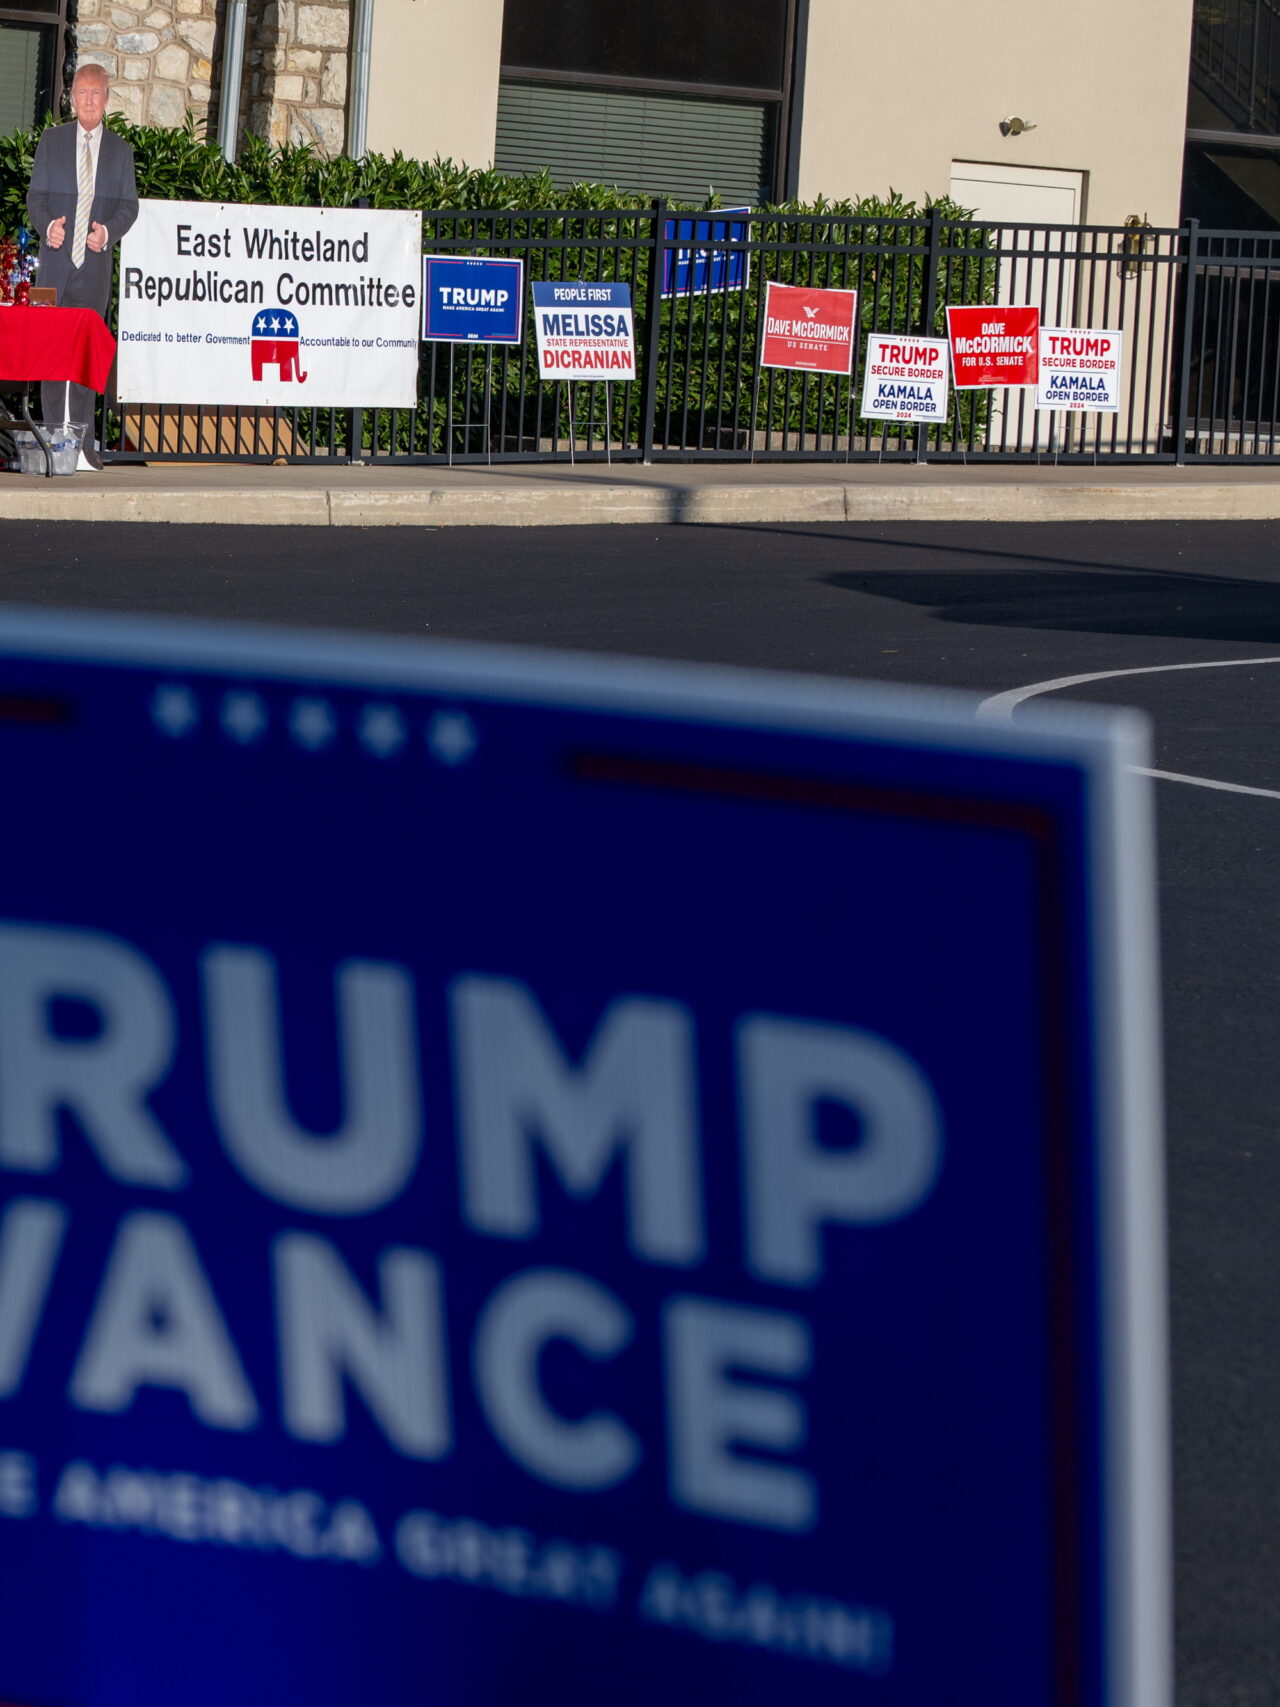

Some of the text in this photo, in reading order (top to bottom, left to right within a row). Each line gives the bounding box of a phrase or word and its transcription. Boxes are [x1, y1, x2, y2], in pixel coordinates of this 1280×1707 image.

[177, 224, 368, 262] East Whiteland
[124, 267, 416, 308] Republican Committee
[554, 288, 612, 301] PEOPLE FIRST
[439, 287, 509, 306] TRUMP
[542, 314, 629, 337] MELISSA
[767, 317, 791, 335] DAVE
[981, 323, 1005, 336] DAVE
[121, 331, 250, 345] Dedicated to better Government
[300, 336, 350, 347] Accountable
[352, 338, 359, 347] to
[376, 337, 417, 349] Community
[547, 338, 628, 348] STATE REPRESENTATIVE
[799, 342, 828, 351] SENATE
[1048, 336, 1111, 357] TRUMP
[543, 350, 632, 369] DICRANIAN
[879, 344, 939, 366] TRUMP
[962, 356, 1023, 367] FOR U.S. SENATE
[1042, 357, 1116, 370] SECURE BORDER
[871, 365, 944, 379] SECURE BORDER
[1050, 375, 1105, 391] KAMALA
[878, 384, 933, 401] KAMALA
[1046, 390, 1109, 402] OPEN BORDER
[873, 399, 937, 413] OPEN BORDER
[52, 1459, 384, 1569] AMERICA
